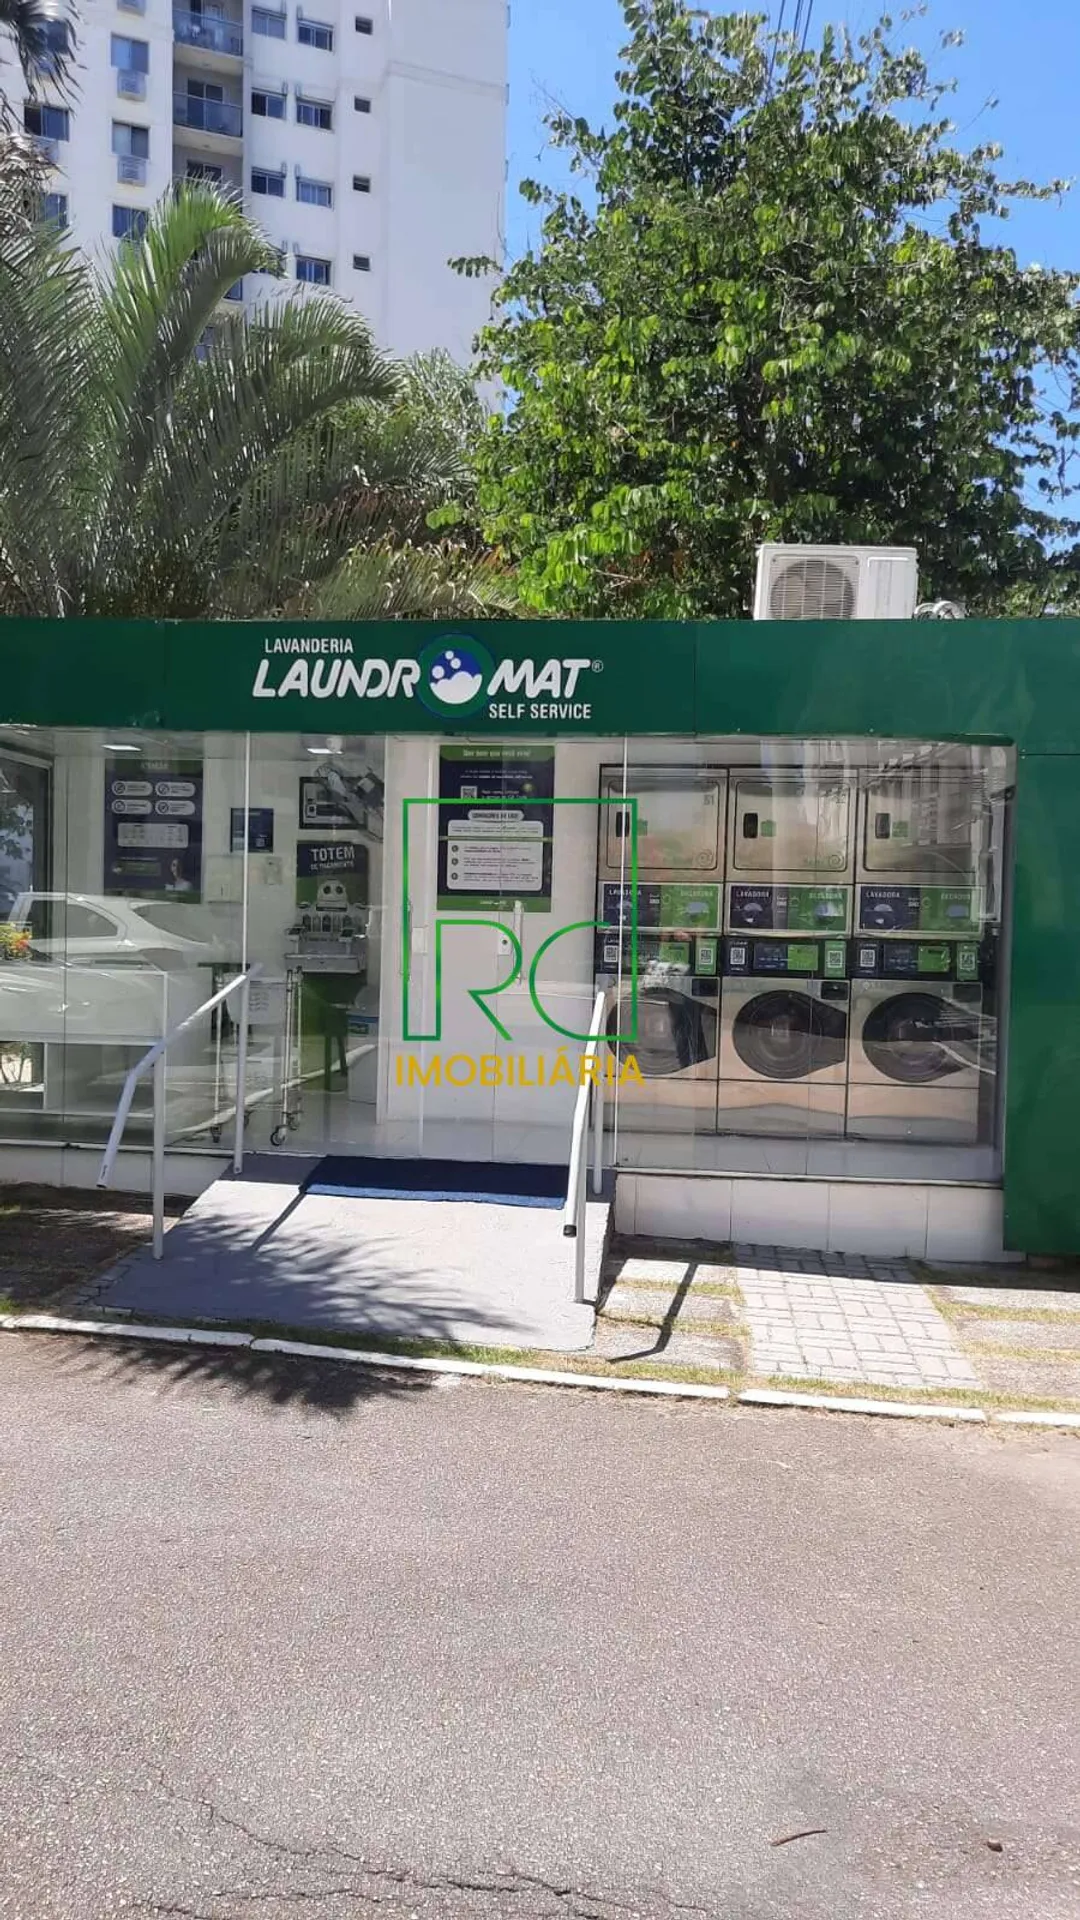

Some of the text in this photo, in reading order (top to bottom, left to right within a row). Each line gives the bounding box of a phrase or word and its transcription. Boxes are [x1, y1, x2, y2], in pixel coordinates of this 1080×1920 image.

[265, 638, 354, 654] LAVANDERIA
[489, 703, 592, 719] SELF SERVICE
[310, 845, 355, 861] TOTEM
